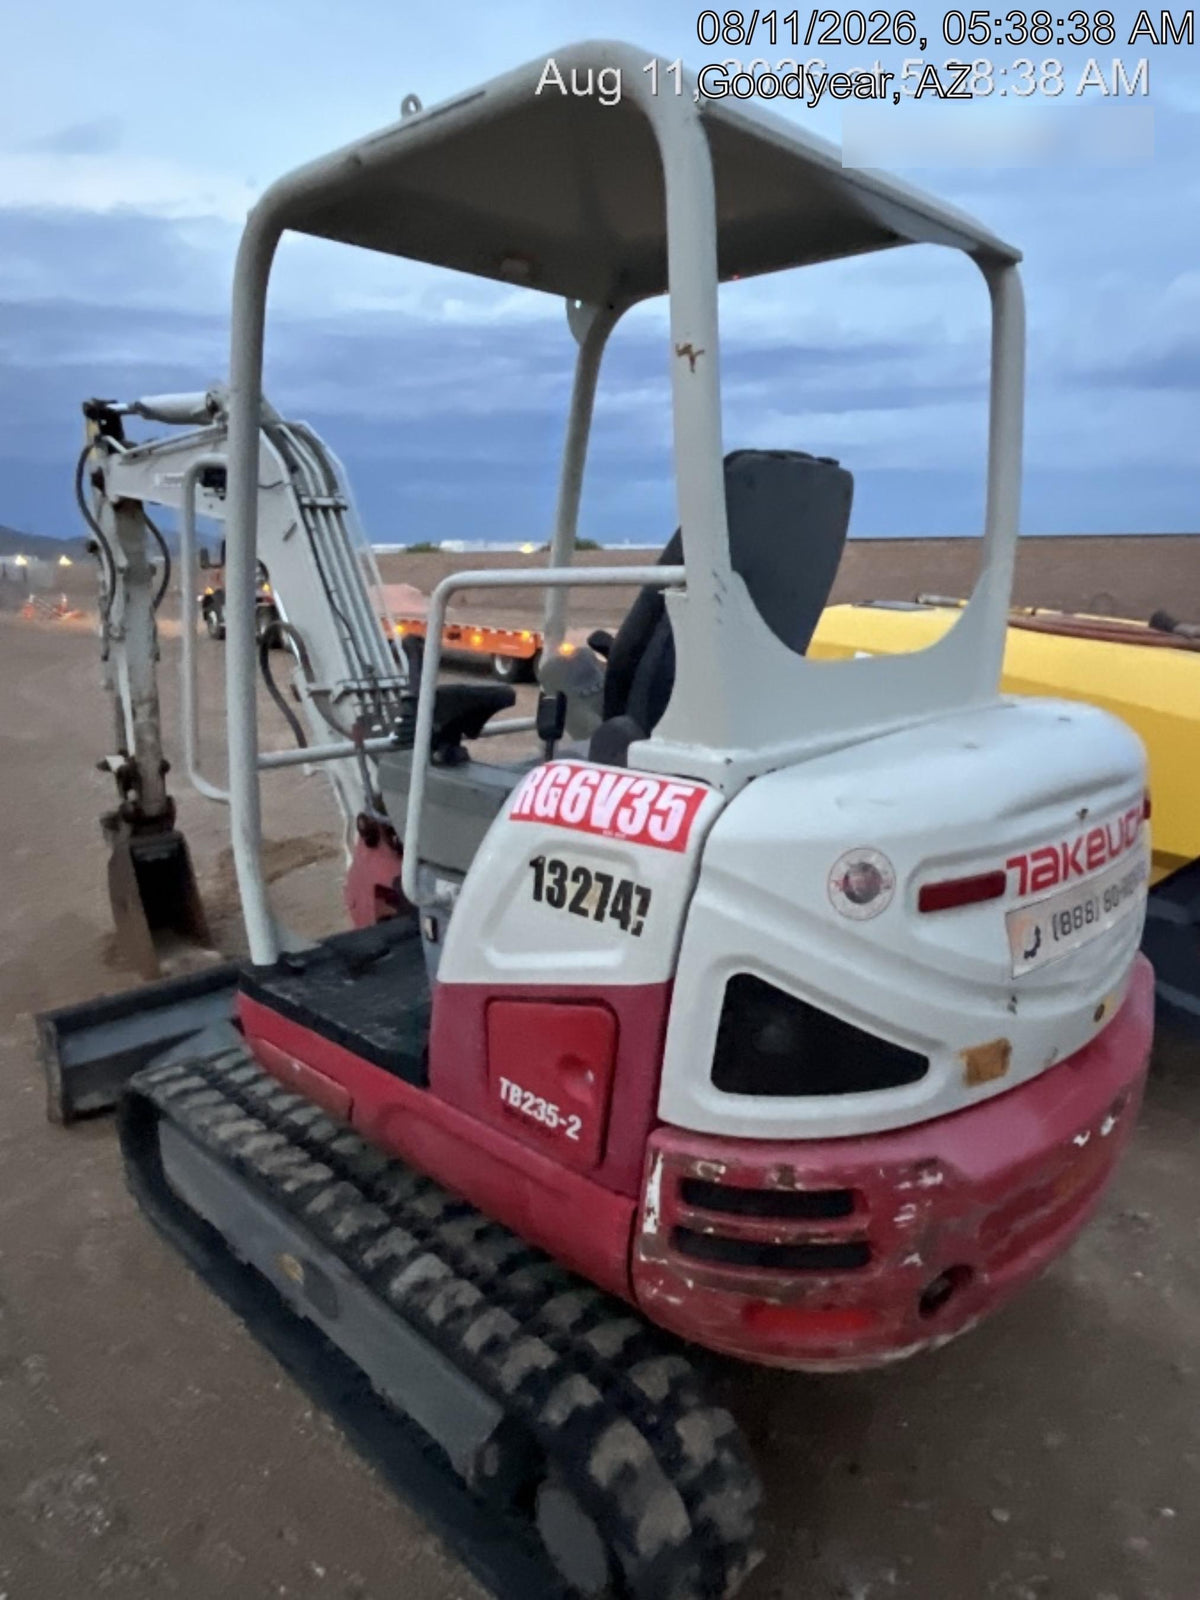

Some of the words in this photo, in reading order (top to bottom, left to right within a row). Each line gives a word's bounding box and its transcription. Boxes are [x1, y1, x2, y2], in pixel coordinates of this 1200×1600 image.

[512, 765, 694, 843] RG6V35
[529, 855, 653, 938] 132747
[499, 1076, 582, 1142] TB235-2
